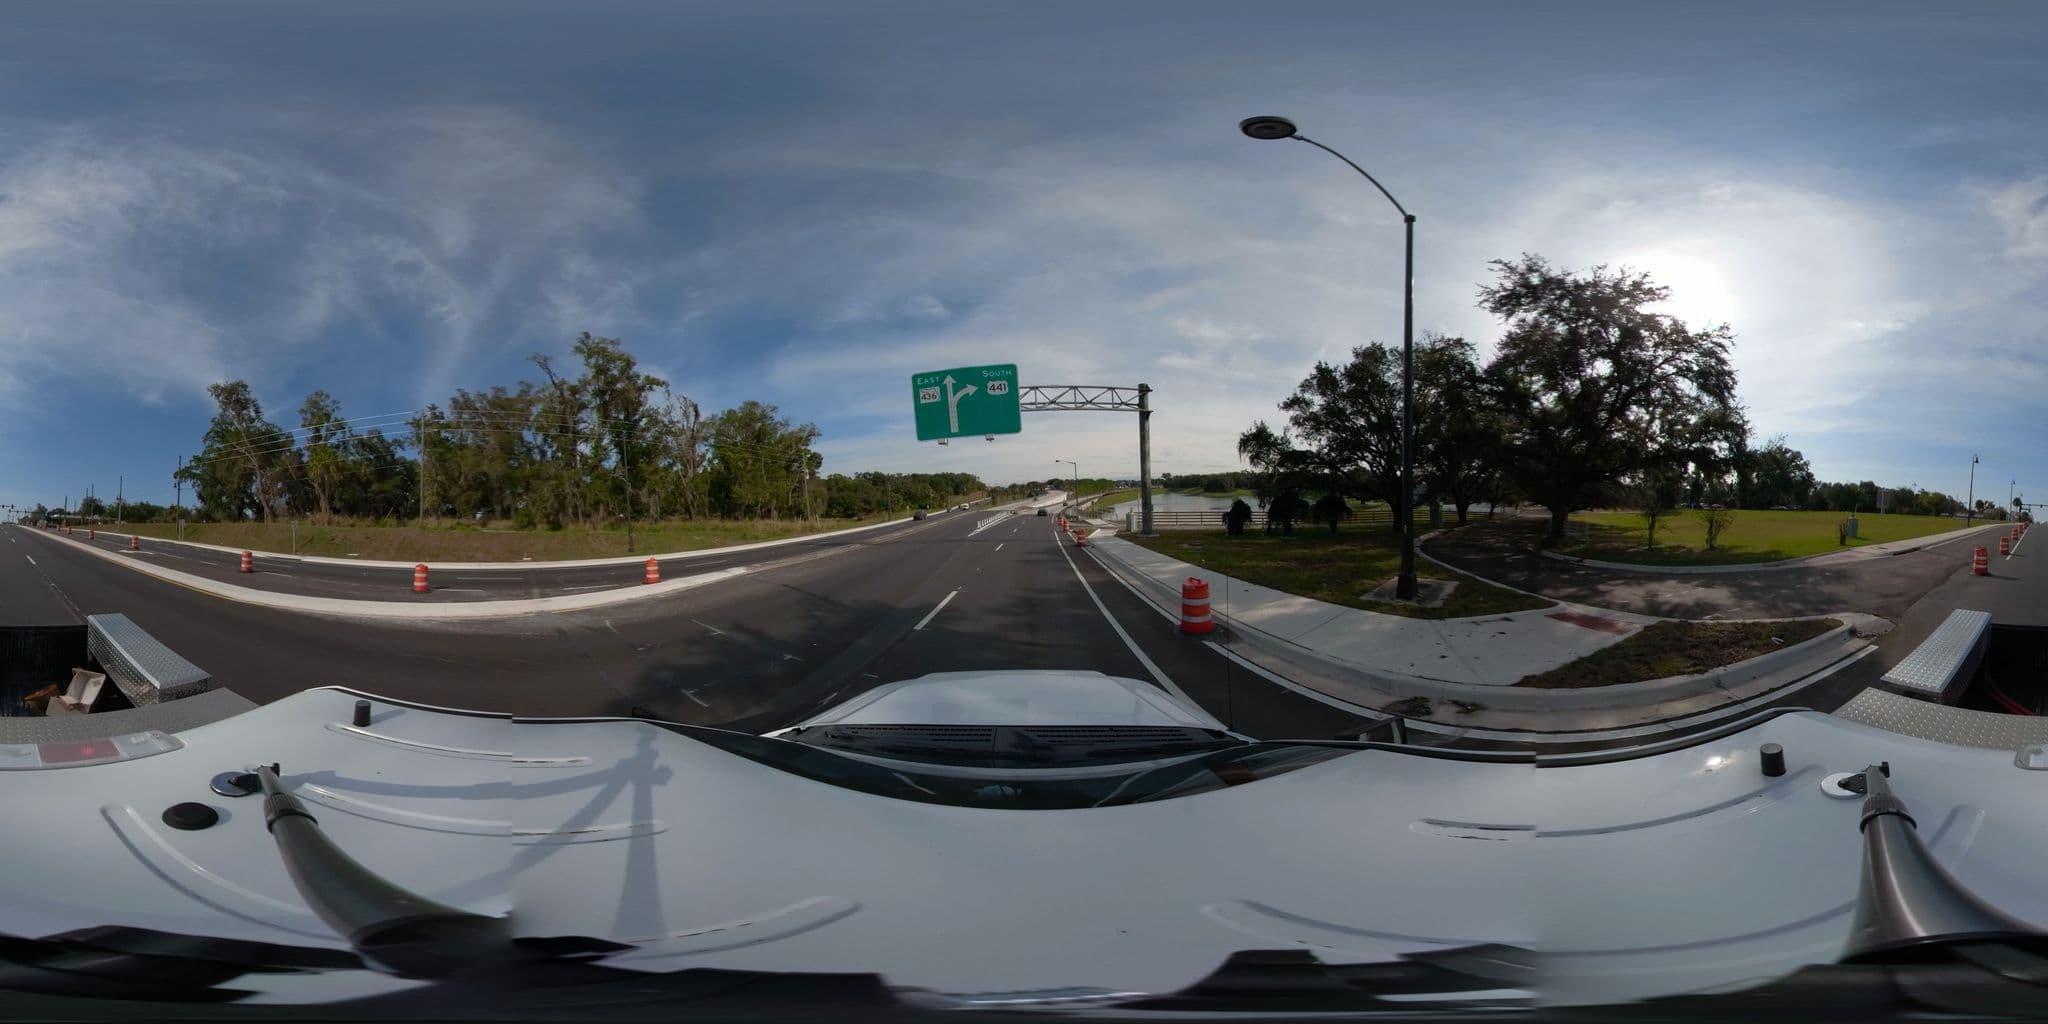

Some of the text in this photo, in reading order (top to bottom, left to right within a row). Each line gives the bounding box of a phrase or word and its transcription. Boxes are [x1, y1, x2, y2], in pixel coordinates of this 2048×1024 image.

[982, 369, 1012, 377] SOUTH
[917, 376, 940, 385] EAST
[989, 383, 1007, 392] 441
[921, 392, 937, 401] 436
